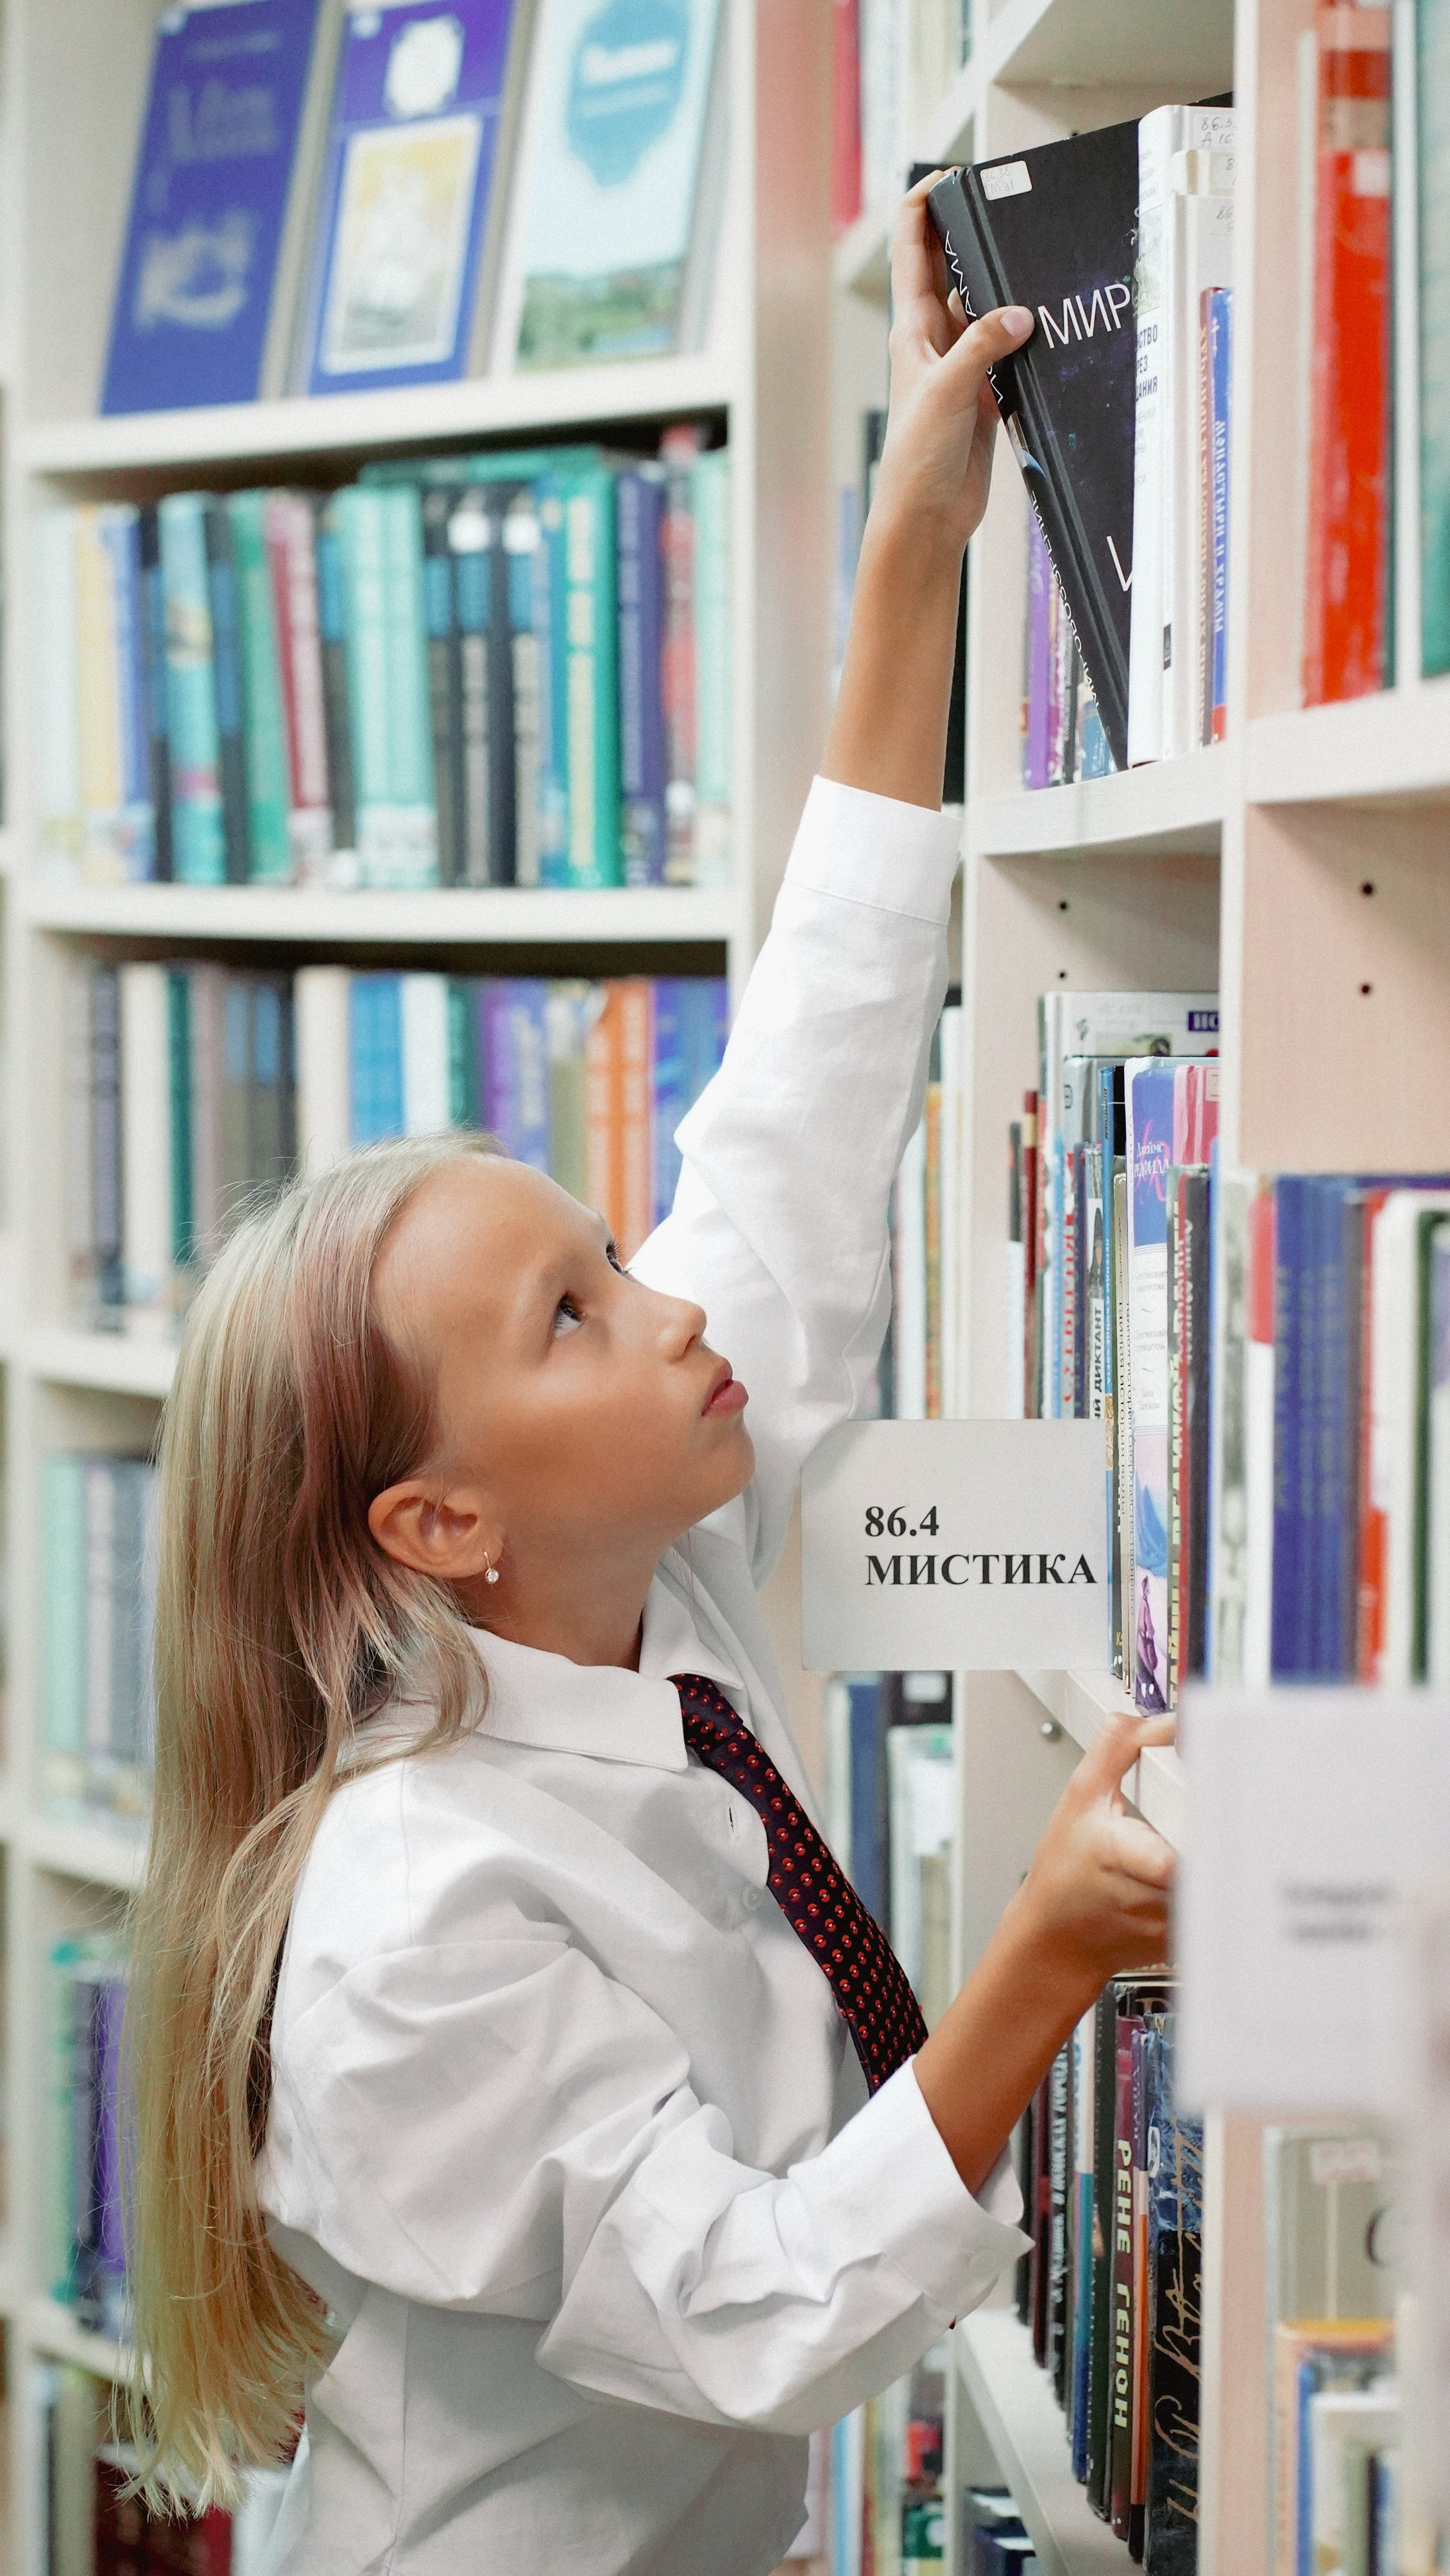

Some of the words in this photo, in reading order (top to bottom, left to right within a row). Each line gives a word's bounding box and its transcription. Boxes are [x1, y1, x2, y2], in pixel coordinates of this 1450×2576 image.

[1037, 283, 1132, 349] МИР
[1094, 1306, 1102, 1393] ДИКТАНТ
[864, 1505, 939, 1537] 86.4
[864, 1554, 1098, 1586] МИСТИКА
[1117, 2139, 1132, 2255] РЕНЕ
[1114, 2283, 1130, 2428] ГЕНОН
